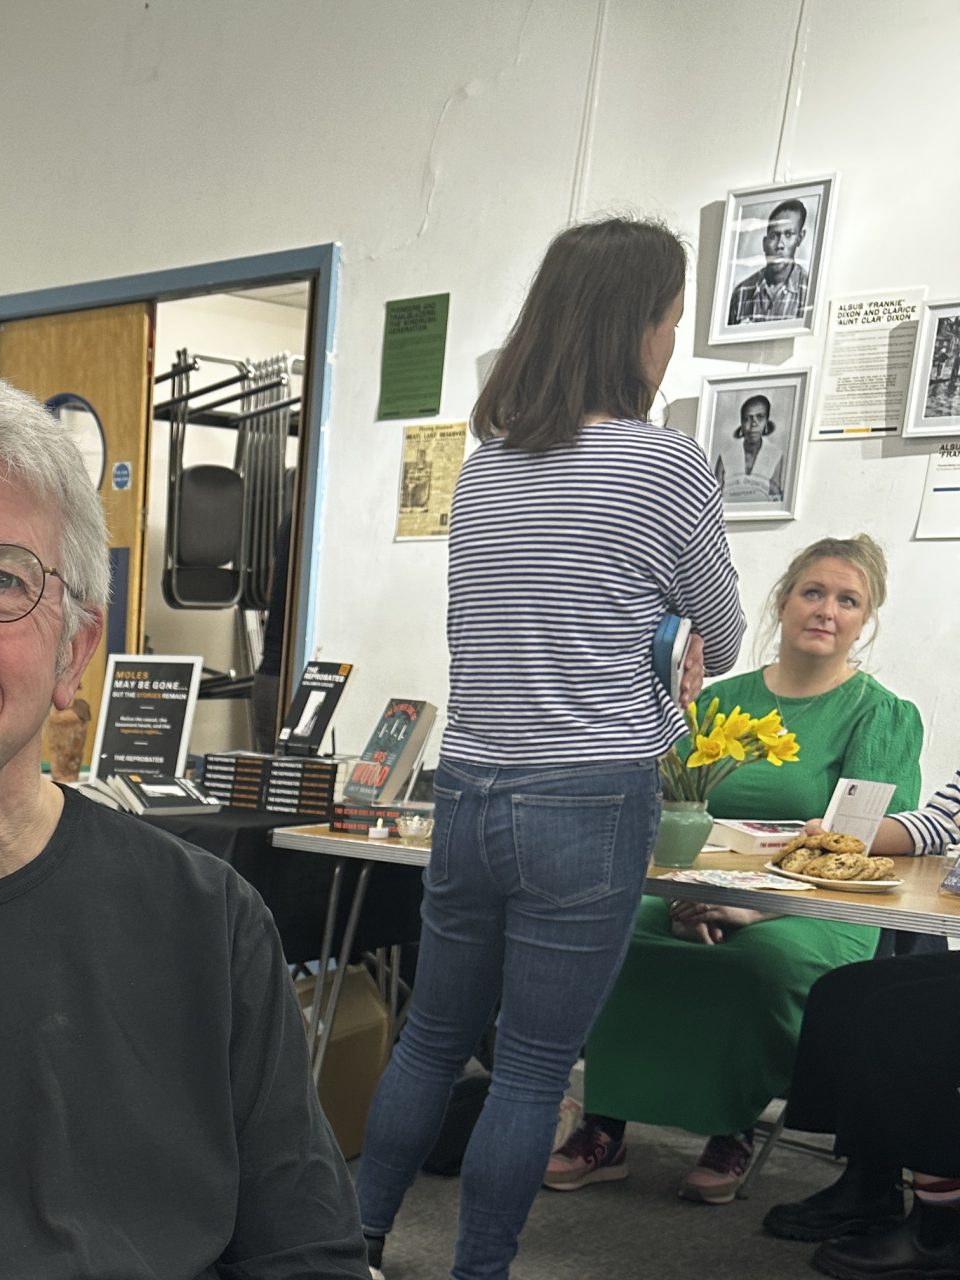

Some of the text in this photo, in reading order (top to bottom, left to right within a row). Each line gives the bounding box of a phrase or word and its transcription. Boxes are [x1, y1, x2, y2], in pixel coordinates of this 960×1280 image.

[838, 311, 861, 319] DIXON
[882, 305, 917, 315] CLARICE
[886, 314, 911, 322] DIXON
[115, 671, 149, 680] MOLES
[113, 680, 188, 691] MAY BE GONE...
[351, 763, 390, 787] WOOD
